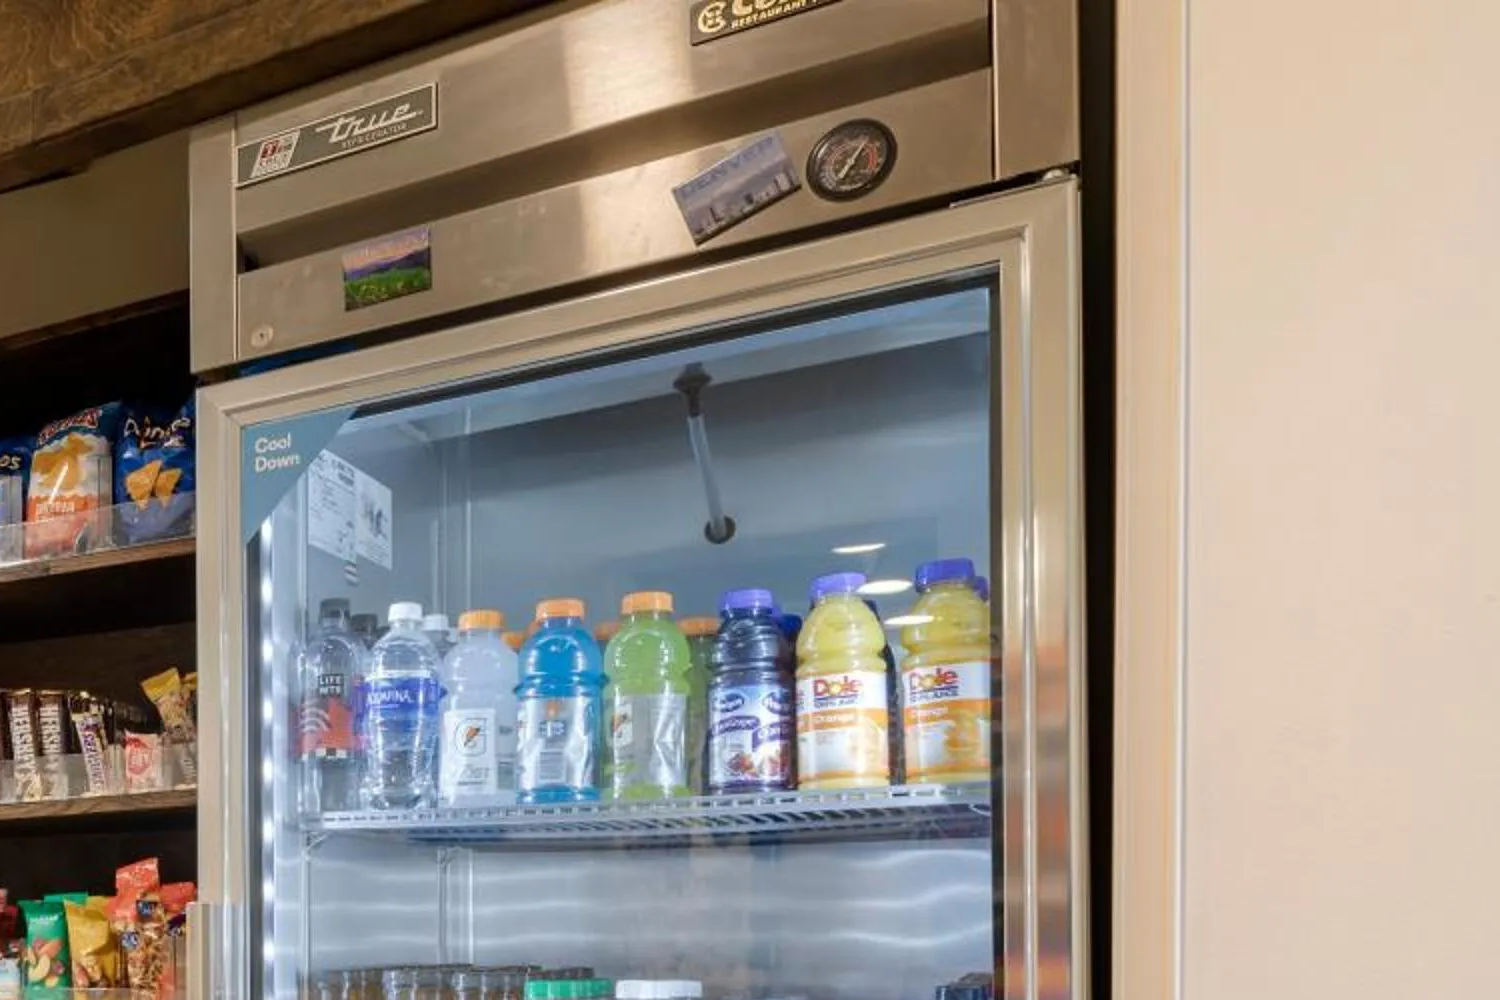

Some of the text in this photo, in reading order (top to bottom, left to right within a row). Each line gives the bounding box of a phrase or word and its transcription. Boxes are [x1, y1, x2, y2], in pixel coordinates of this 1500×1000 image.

[254, 434, 292, 453] Cool
[254, 454, 300, 472] Down
[813, 675, 862, 697] Dole
[909, 665, 959, 691] Dole
